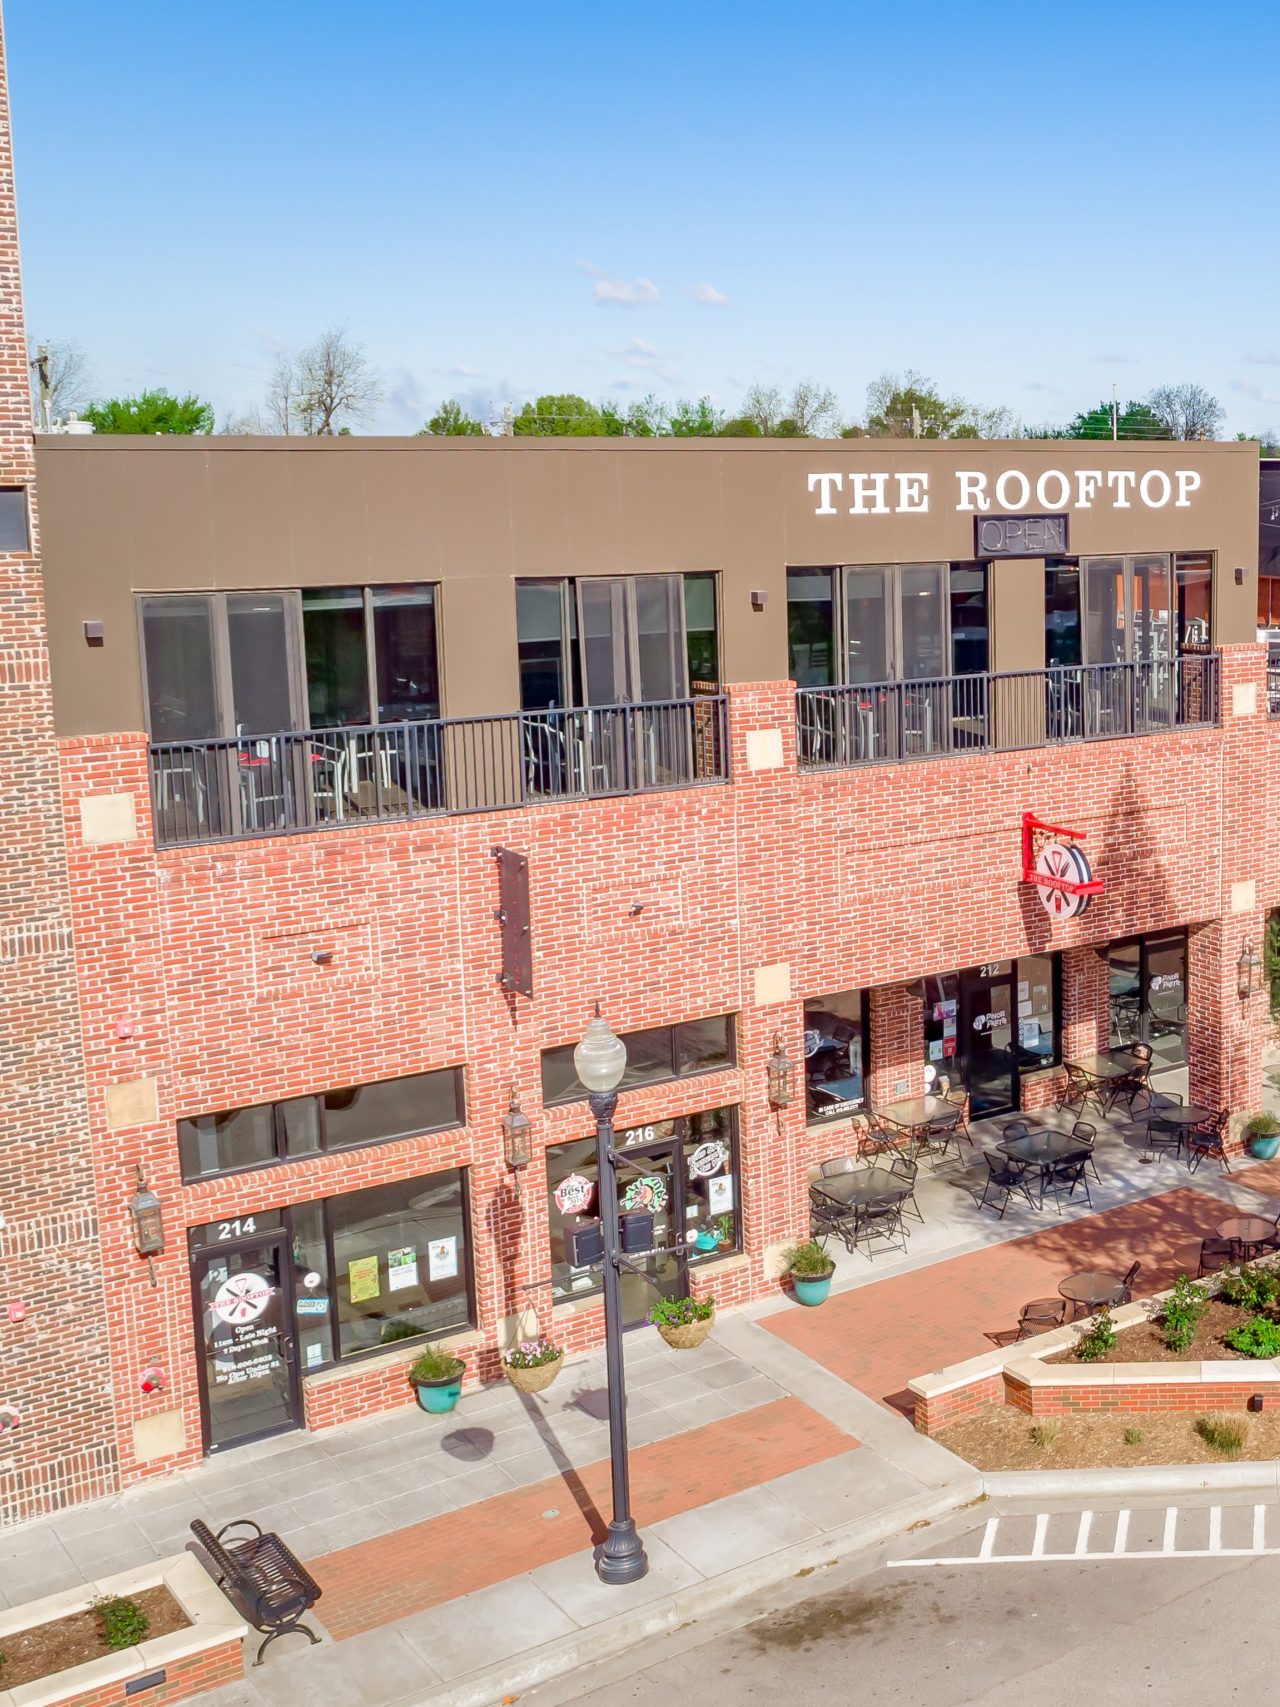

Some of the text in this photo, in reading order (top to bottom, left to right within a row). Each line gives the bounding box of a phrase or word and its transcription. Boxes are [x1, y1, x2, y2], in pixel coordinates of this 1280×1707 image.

[807, 469, 1202, 515] THE ROOFTOP
[979, 518, 1064, 553] OPEN
[980, 963, 999, 978] 212
[625, 1126, 654, 1146] 216
[560, 1184, 585, 1199] Best
[218, 1217, 256, 1240] 214
[235, 1324, 255, 1334] Open
